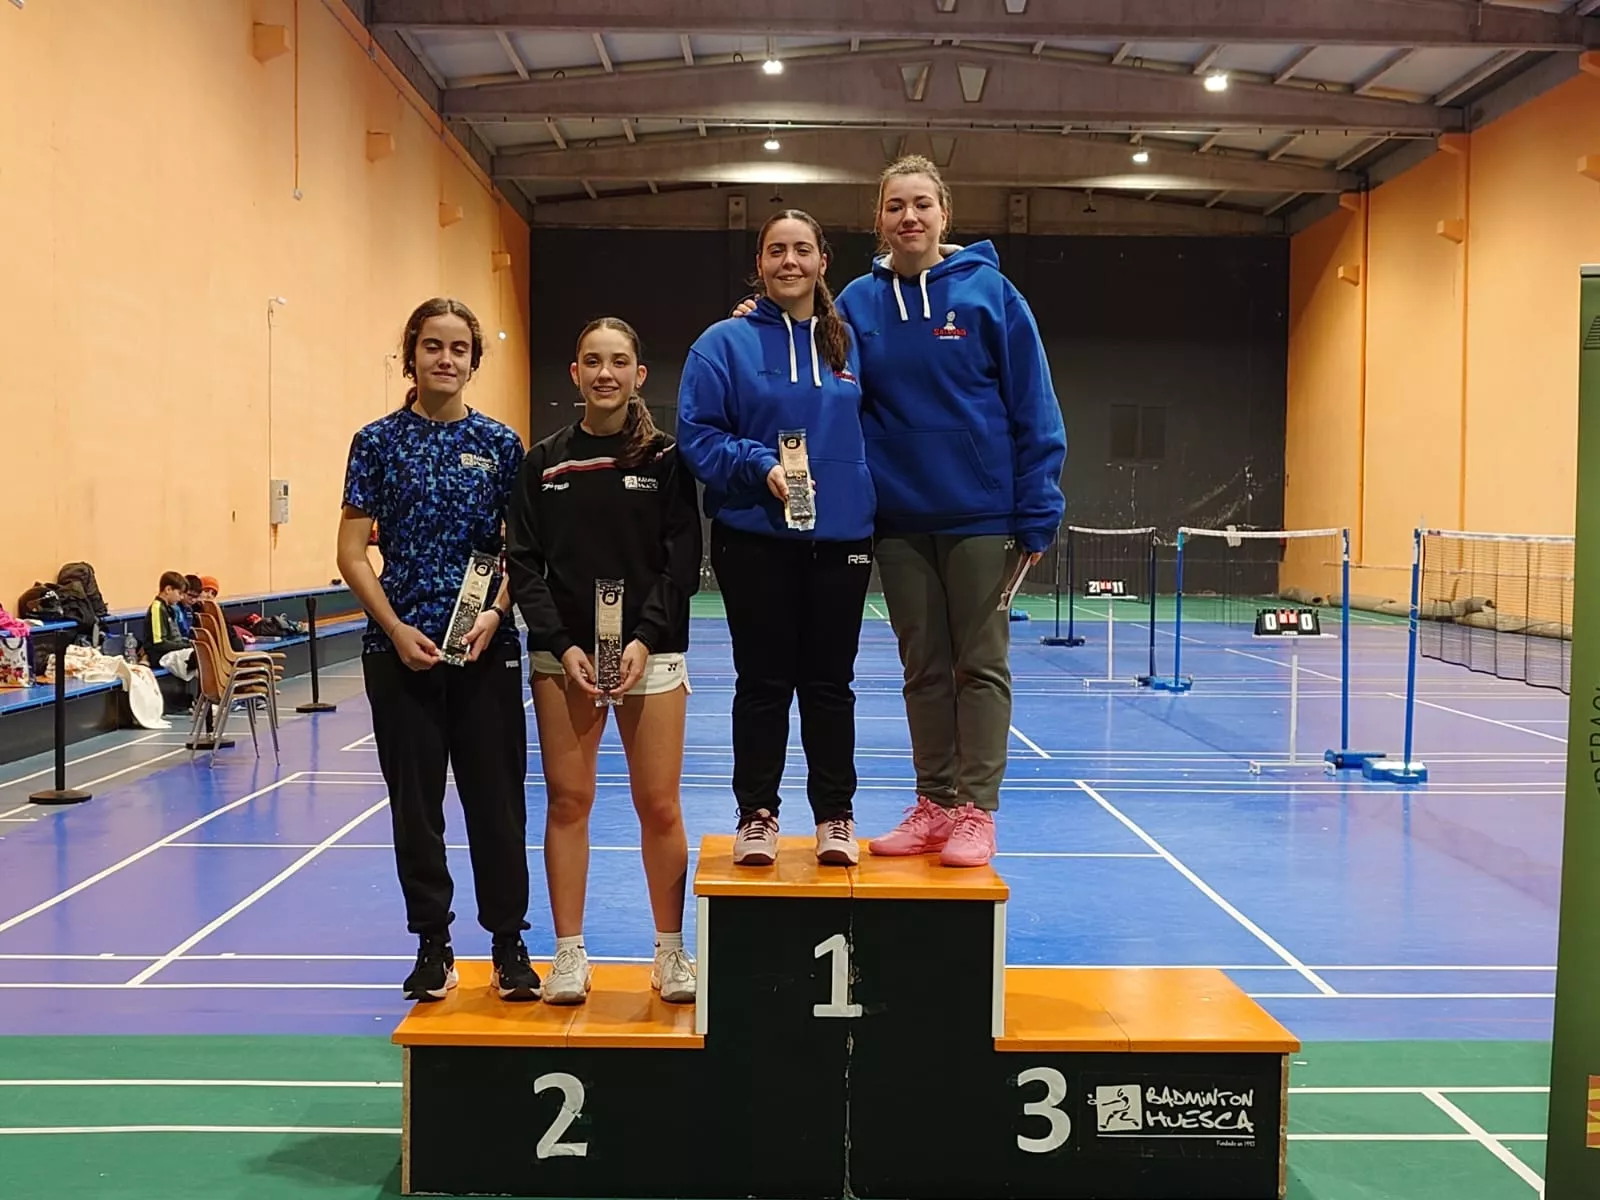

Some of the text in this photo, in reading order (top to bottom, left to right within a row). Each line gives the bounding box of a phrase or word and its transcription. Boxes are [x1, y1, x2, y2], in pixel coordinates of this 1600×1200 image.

[848, 554, 871, 564] RSL
[1088, 581, 1100, 593] 21
[1112, 581, 1123, 593] 11
[1265, 613, 1277, 630] 0
[1301, 613, 1313, 630] 0
[814, 934, 863, 1017] 1
[534, 1073, 588, 1159] 2
[1017, 1067, 1071, 1153] 3
[1146, 1110, 1254, 1133] HUESCA
